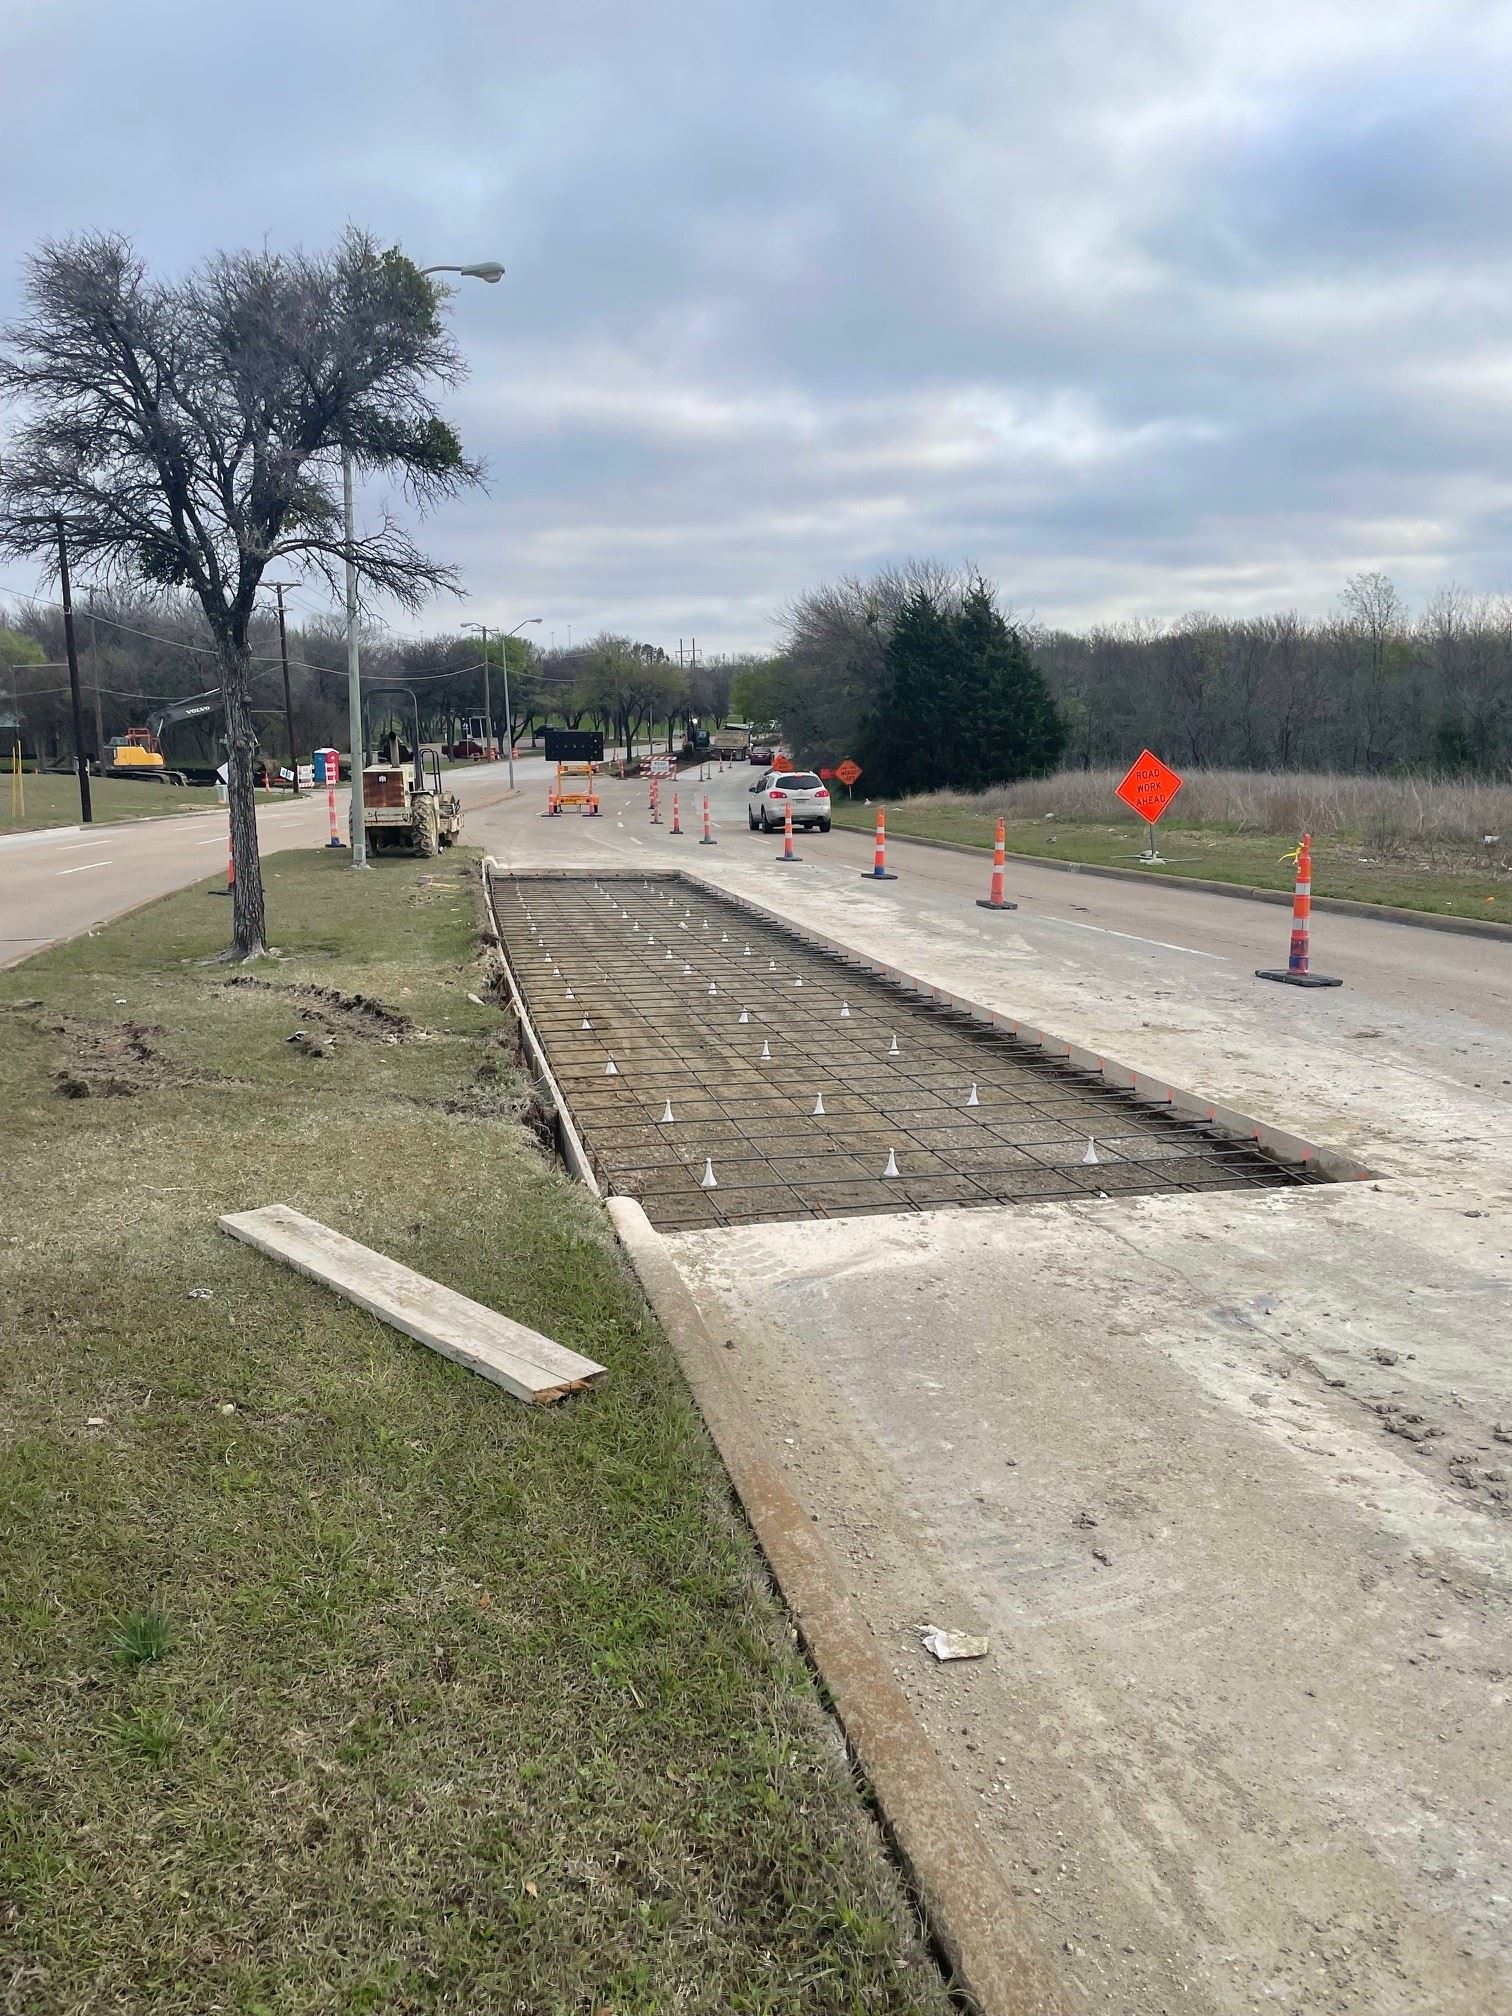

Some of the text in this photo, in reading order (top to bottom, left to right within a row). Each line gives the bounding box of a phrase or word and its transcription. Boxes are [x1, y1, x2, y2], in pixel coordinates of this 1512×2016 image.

[185, 706, 210, 714] VOLVO
[1136, 768, 1160, 780] ROAD
[1137, 781, 1161, 793] WORK
[1136, 794, 1166, 807] AHEAD
